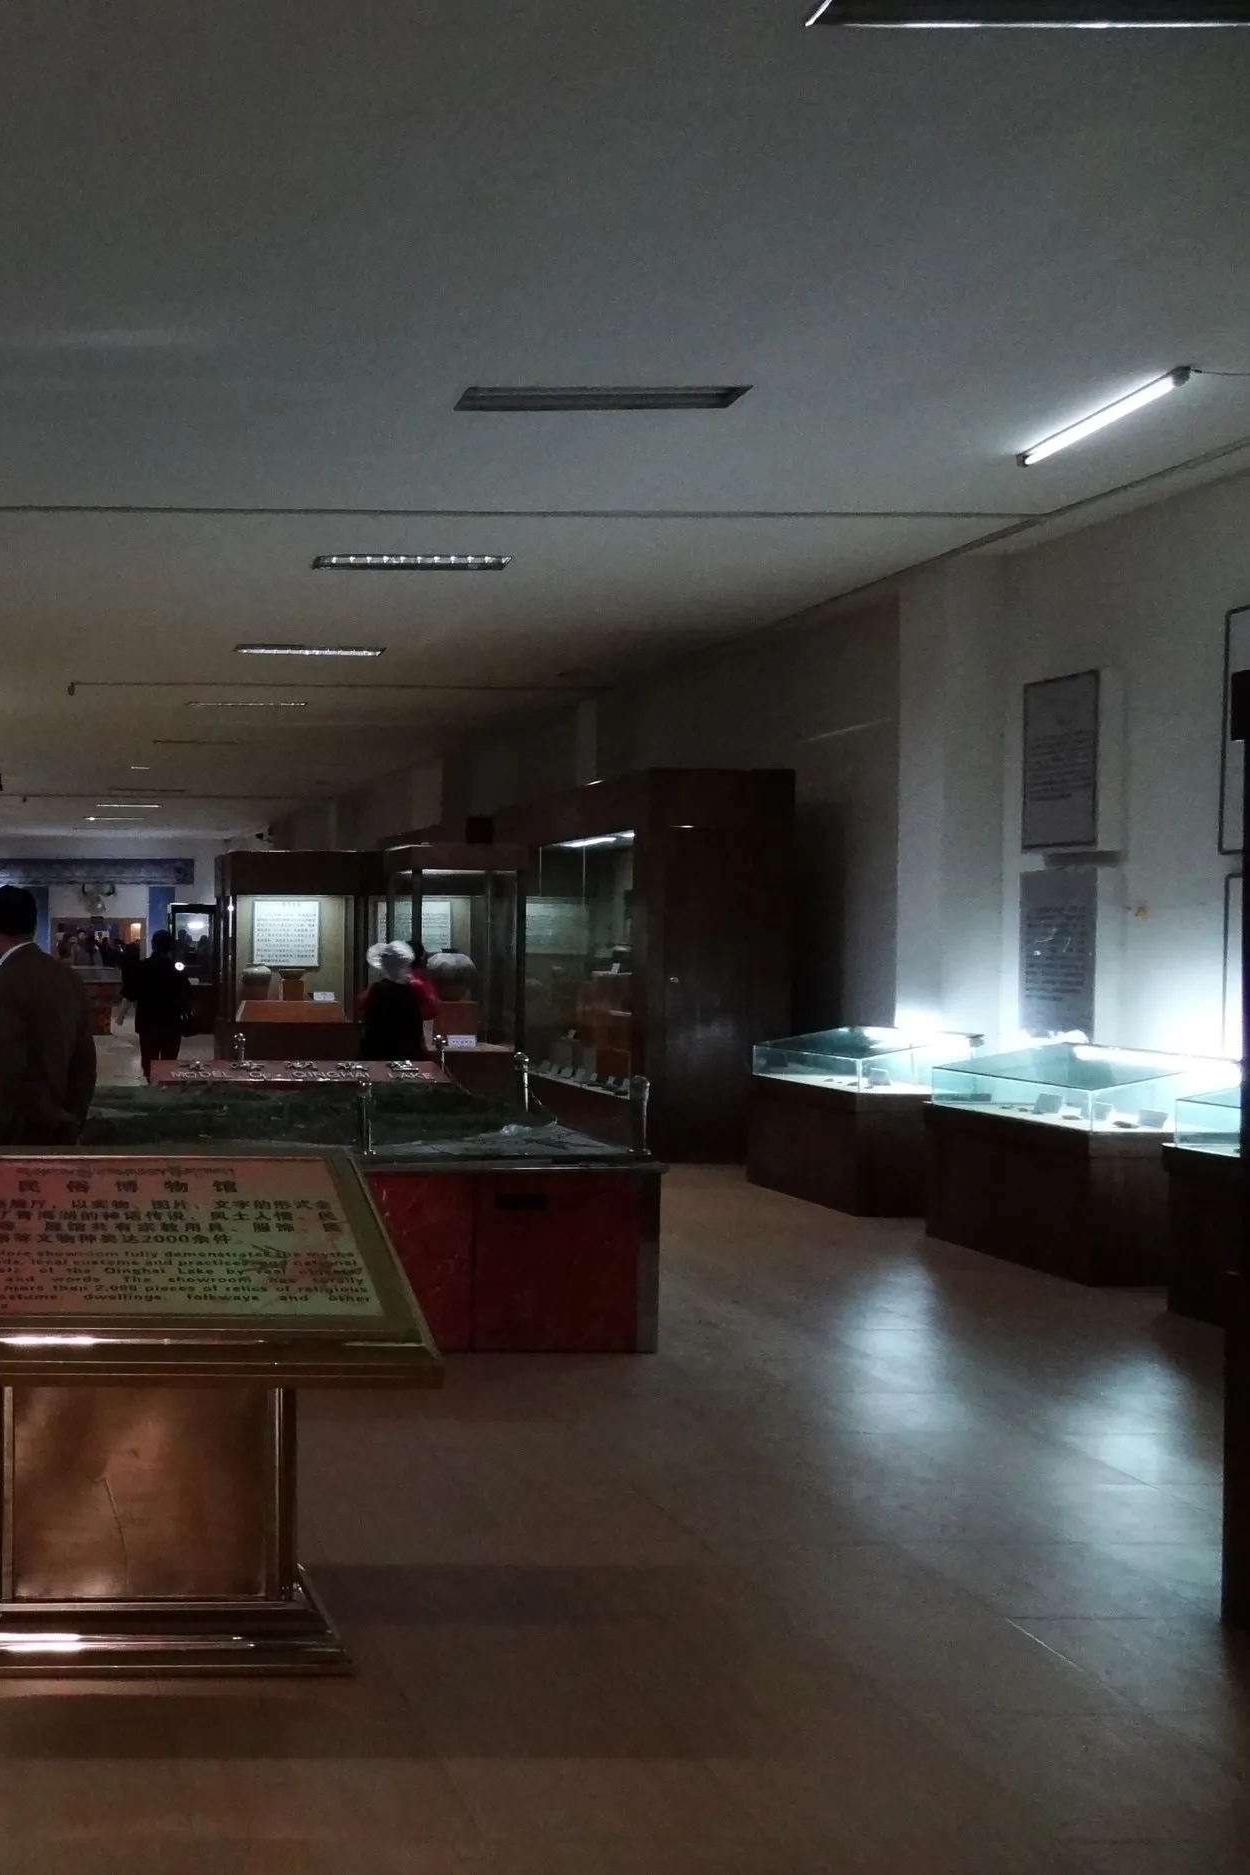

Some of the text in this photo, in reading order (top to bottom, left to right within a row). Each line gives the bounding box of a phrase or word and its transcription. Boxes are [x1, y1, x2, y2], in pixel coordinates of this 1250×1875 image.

[387, 1071, 435, 1080] LAKE
[18, 1180, 238, 1193] 民俗博物馆
[145, 1259, 173, 1267] and
[178, 1267, 214, 1275] Lake
[6, 1276, 35, 1284] and
[279, 1293, 310, 1301] and
